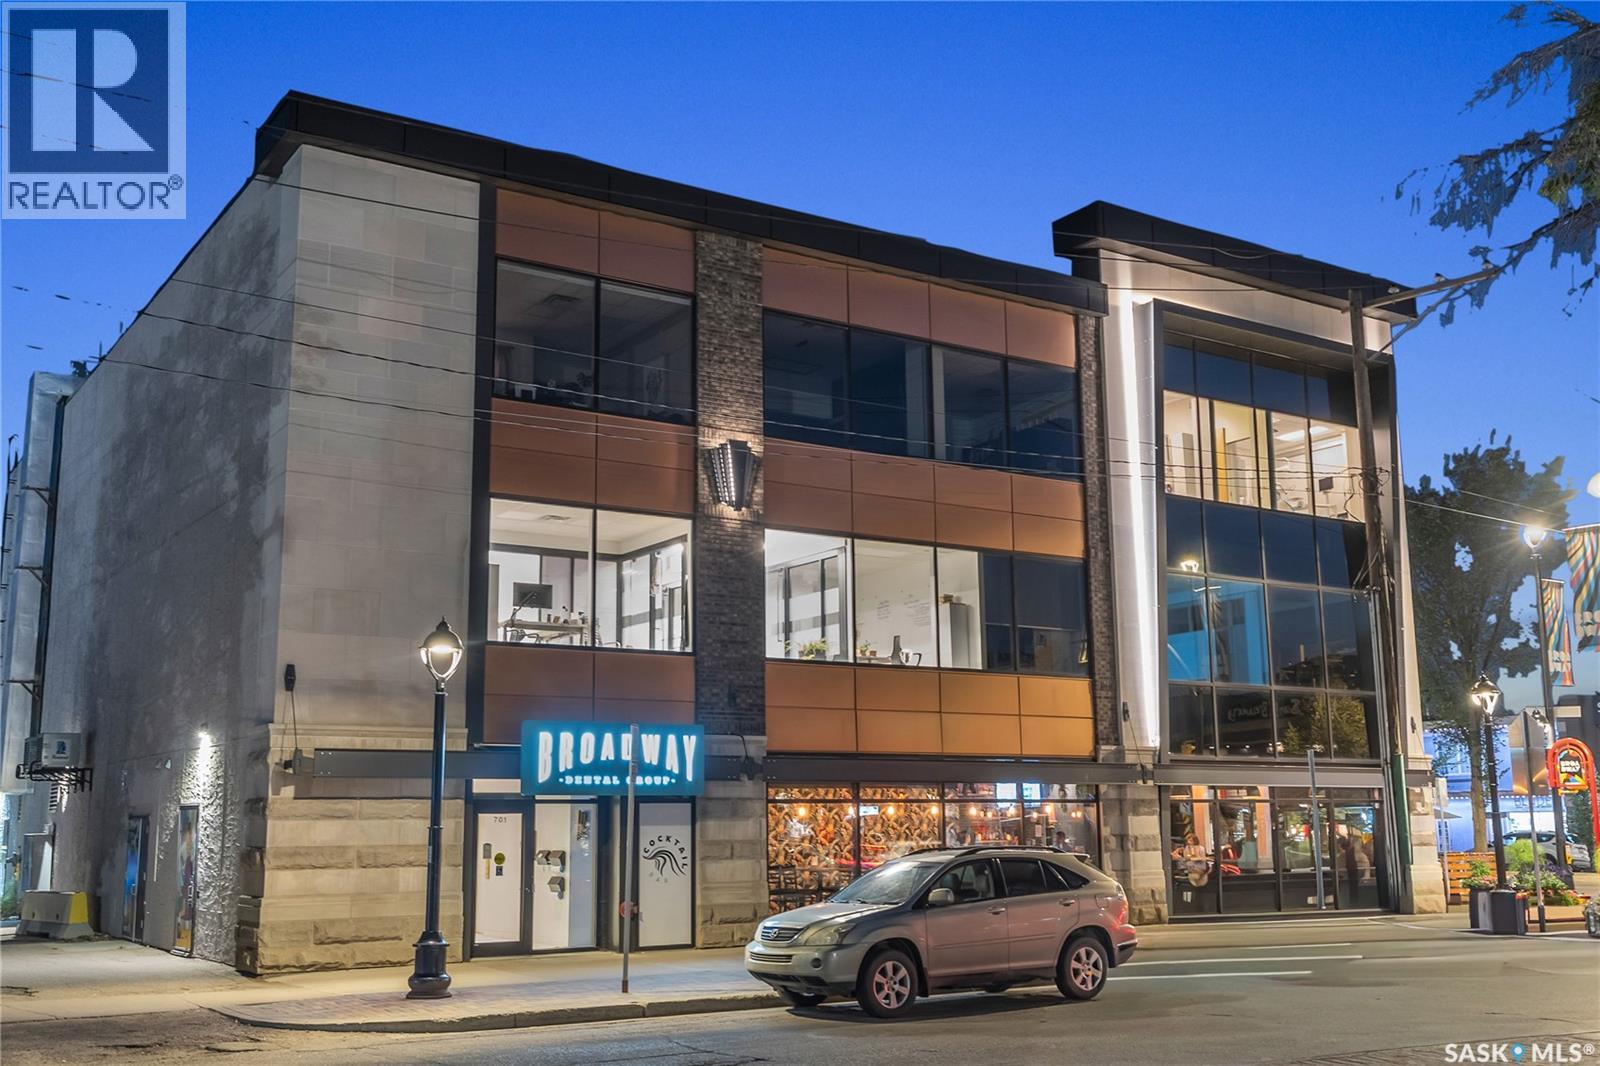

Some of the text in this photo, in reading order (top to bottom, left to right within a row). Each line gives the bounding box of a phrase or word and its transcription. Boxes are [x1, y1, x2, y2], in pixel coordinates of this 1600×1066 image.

[538, 731, 697, 784] BROADWAY
[565, 775, 620, 785] DENTAL
[493, 816, 507, 824] 701
[643, 835, 688, 869] COCKTAIL
